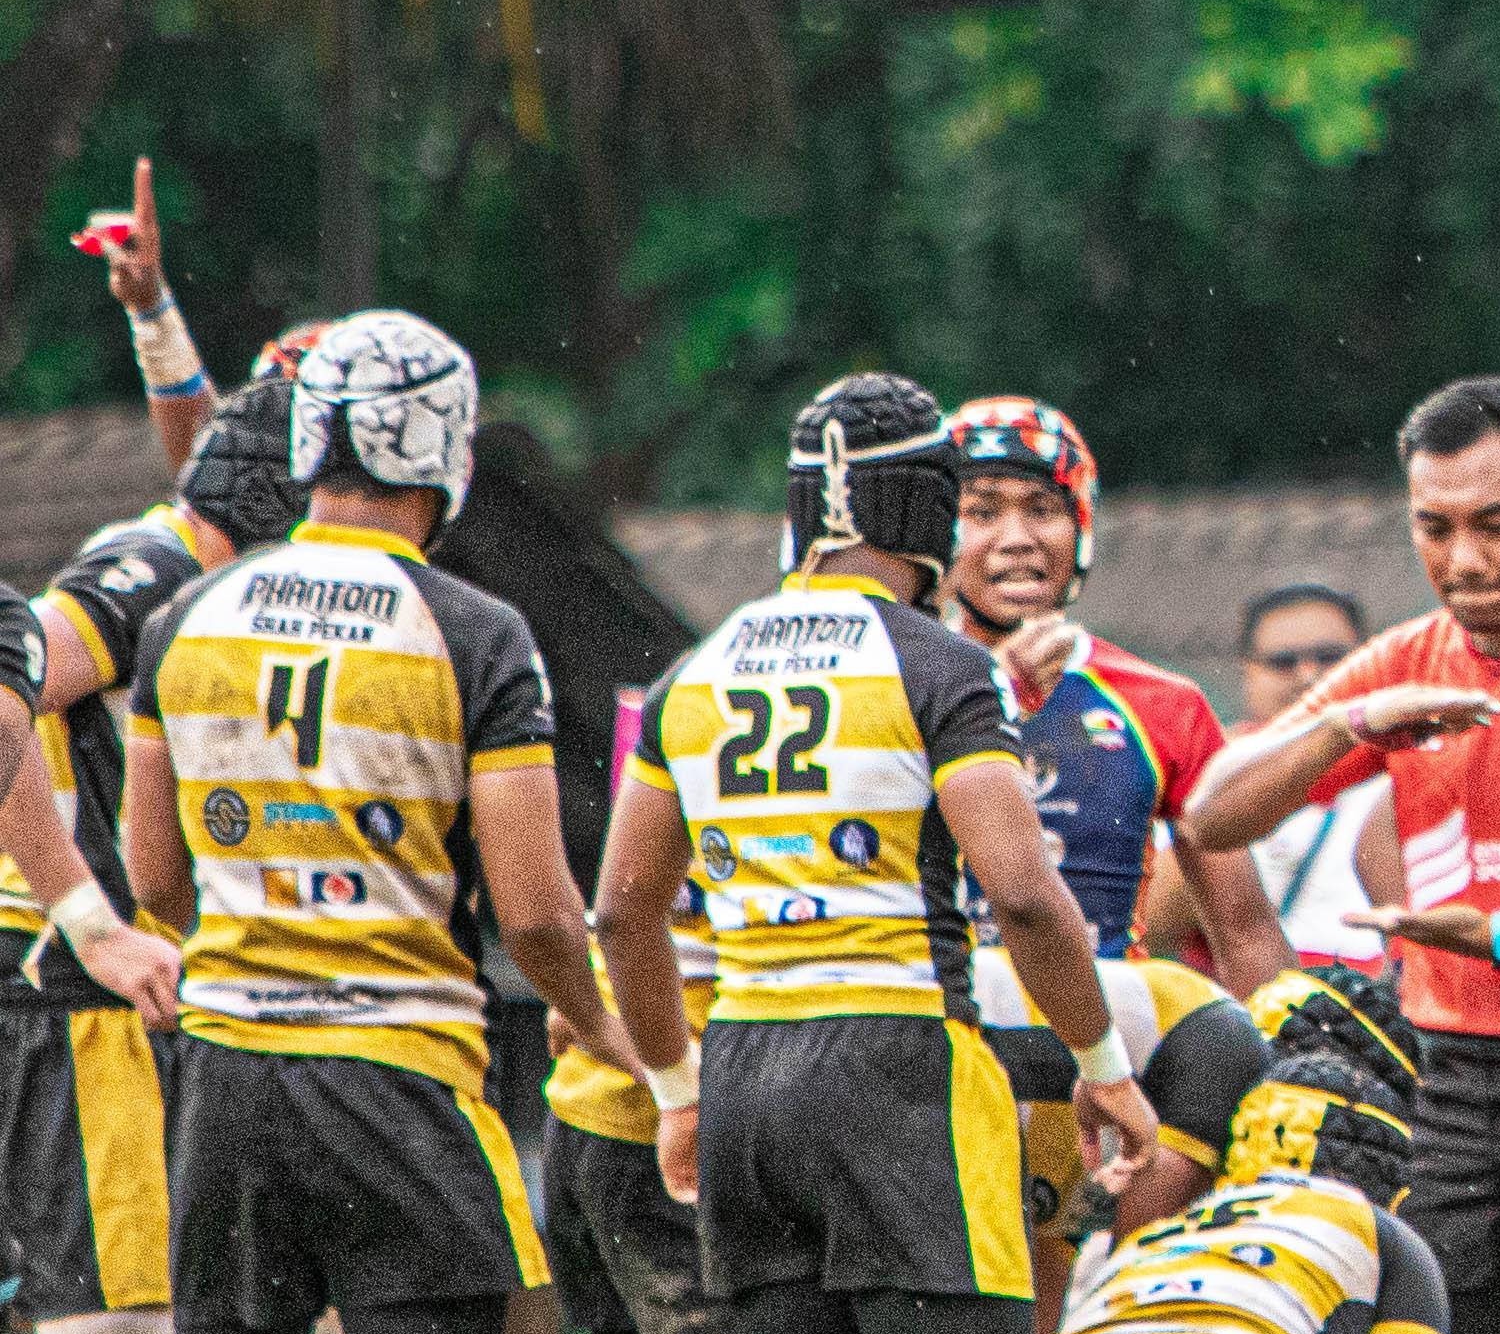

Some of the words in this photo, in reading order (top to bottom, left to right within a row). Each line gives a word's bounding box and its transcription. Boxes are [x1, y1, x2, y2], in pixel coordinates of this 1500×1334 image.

[239, 571, 402, 627] PHANTOM
[724, 613, 871, 658] PHANTOM
[266, 656, 330, 771] 4
[717, 685, 831, 799] 22
